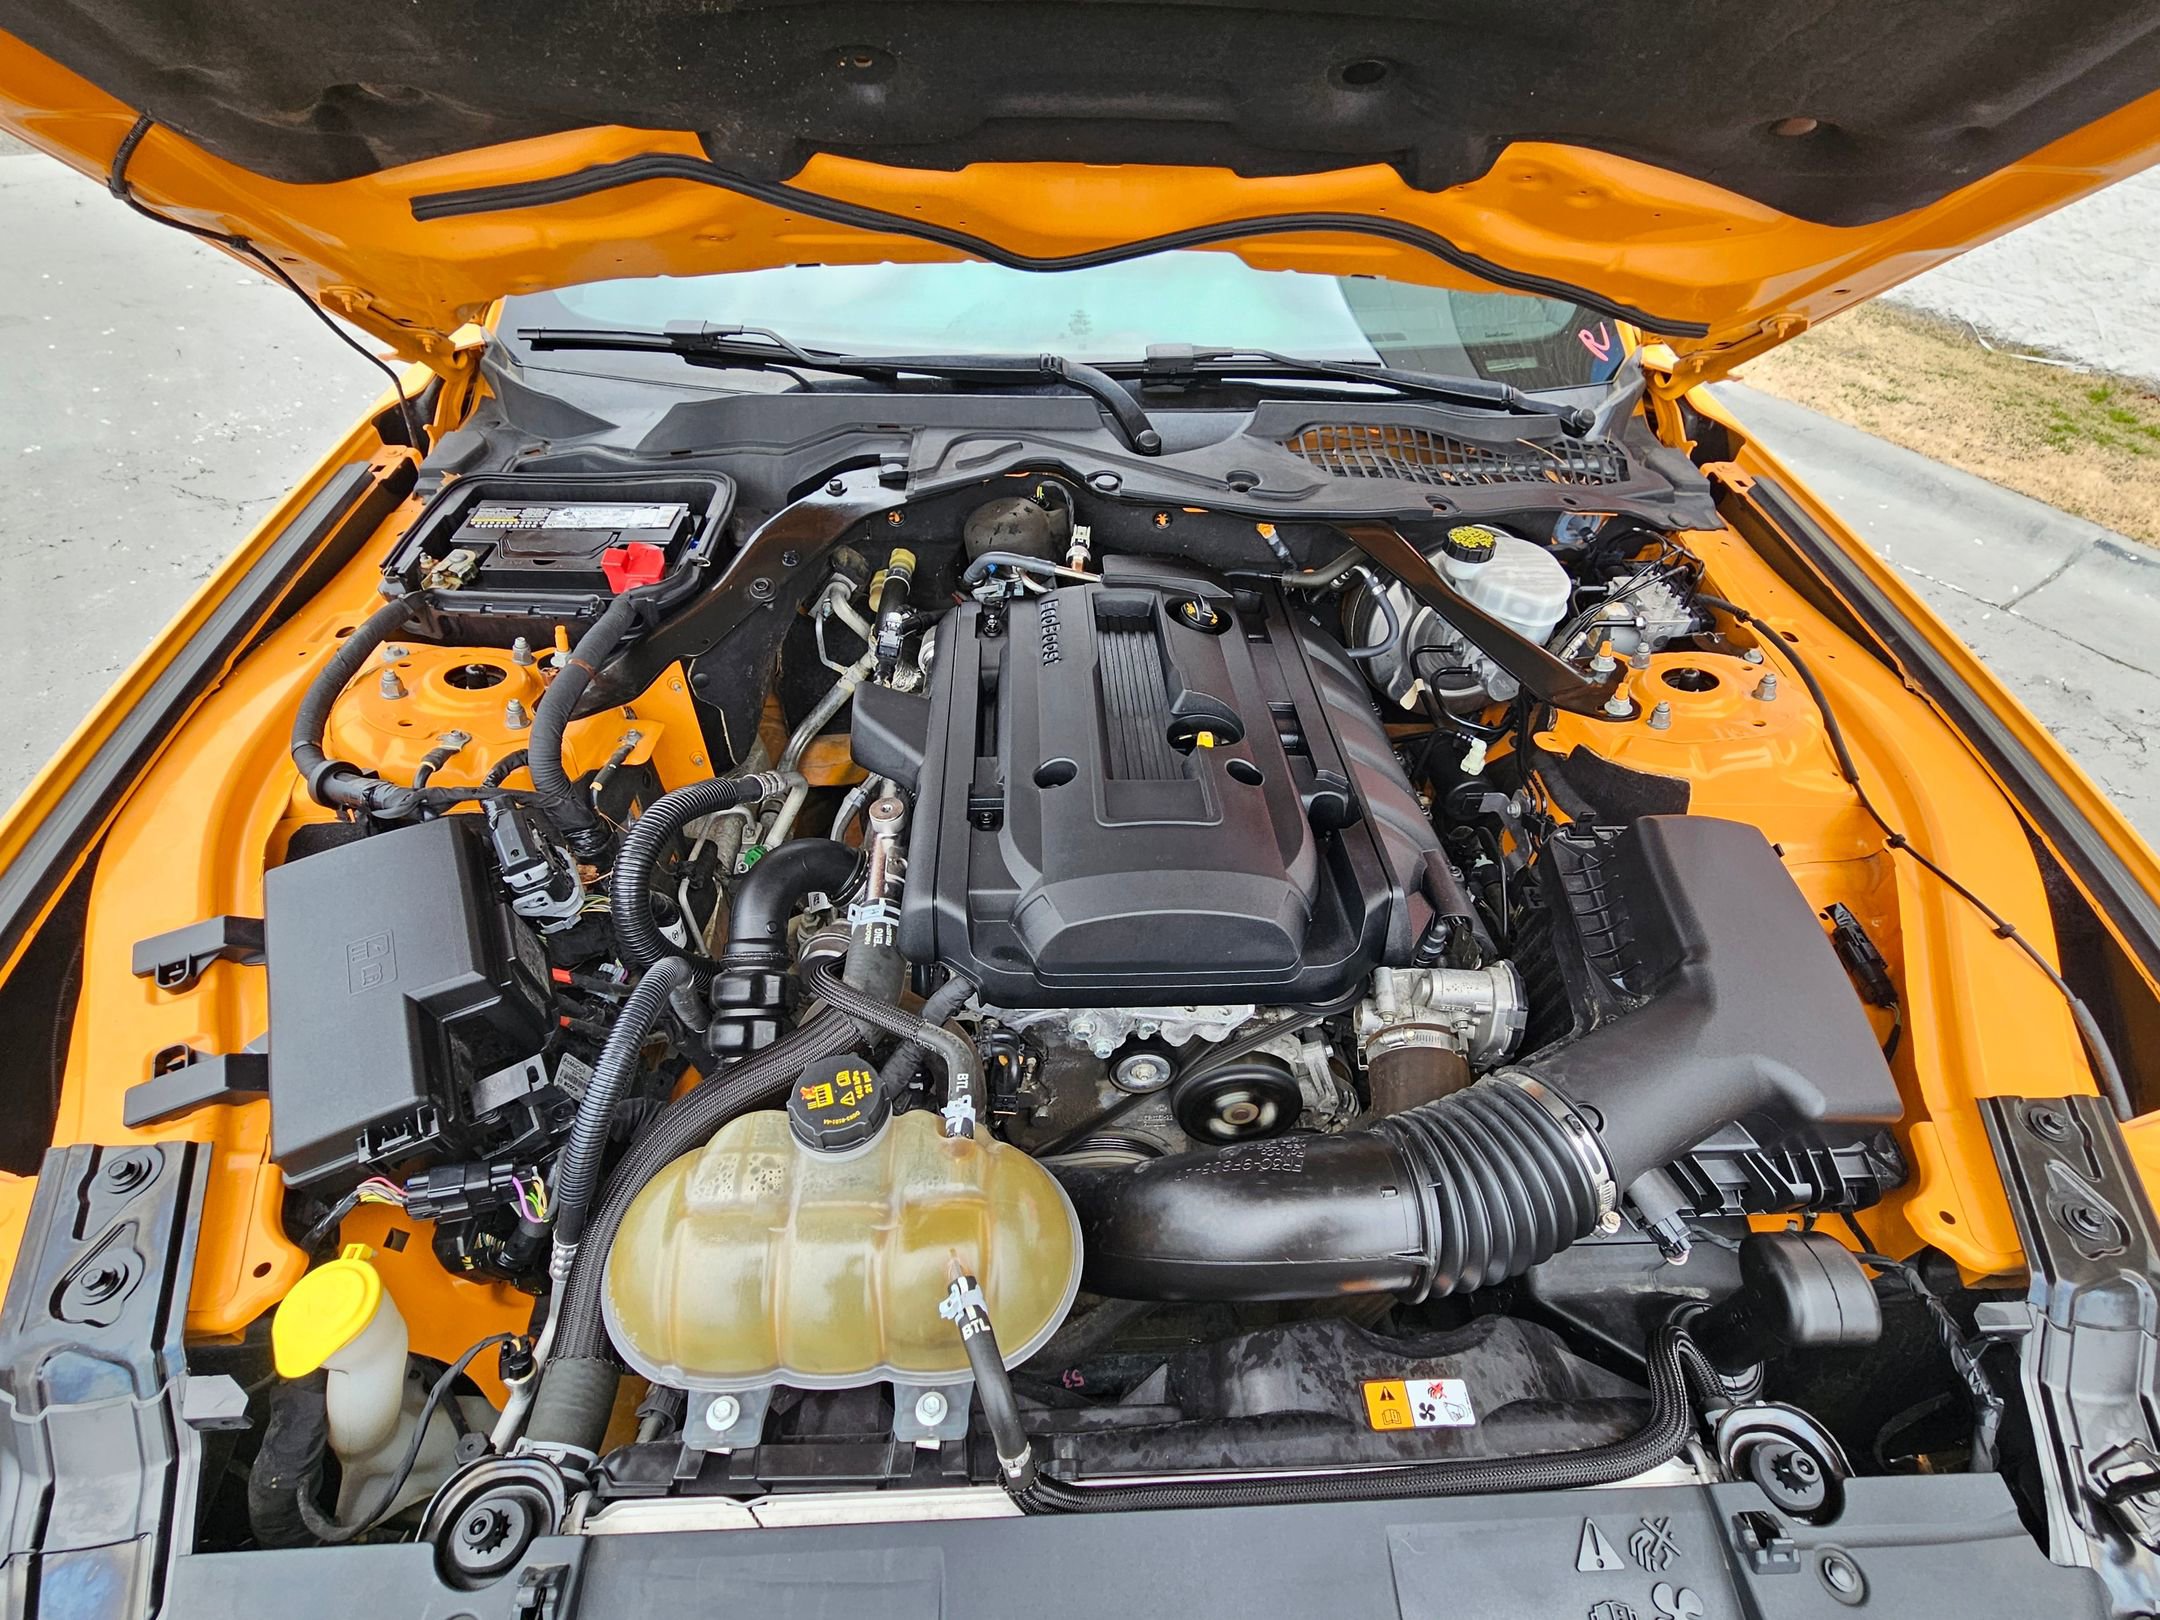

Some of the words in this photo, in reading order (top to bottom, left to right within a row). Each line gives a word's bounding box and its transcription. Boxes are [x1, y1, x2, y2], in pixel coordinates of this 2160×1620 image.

[1040, 599, 1062, 667] EcoBoost
[955, 1073, 969, 1093] BTL
[961, 1318, 991, 1341] BTL
